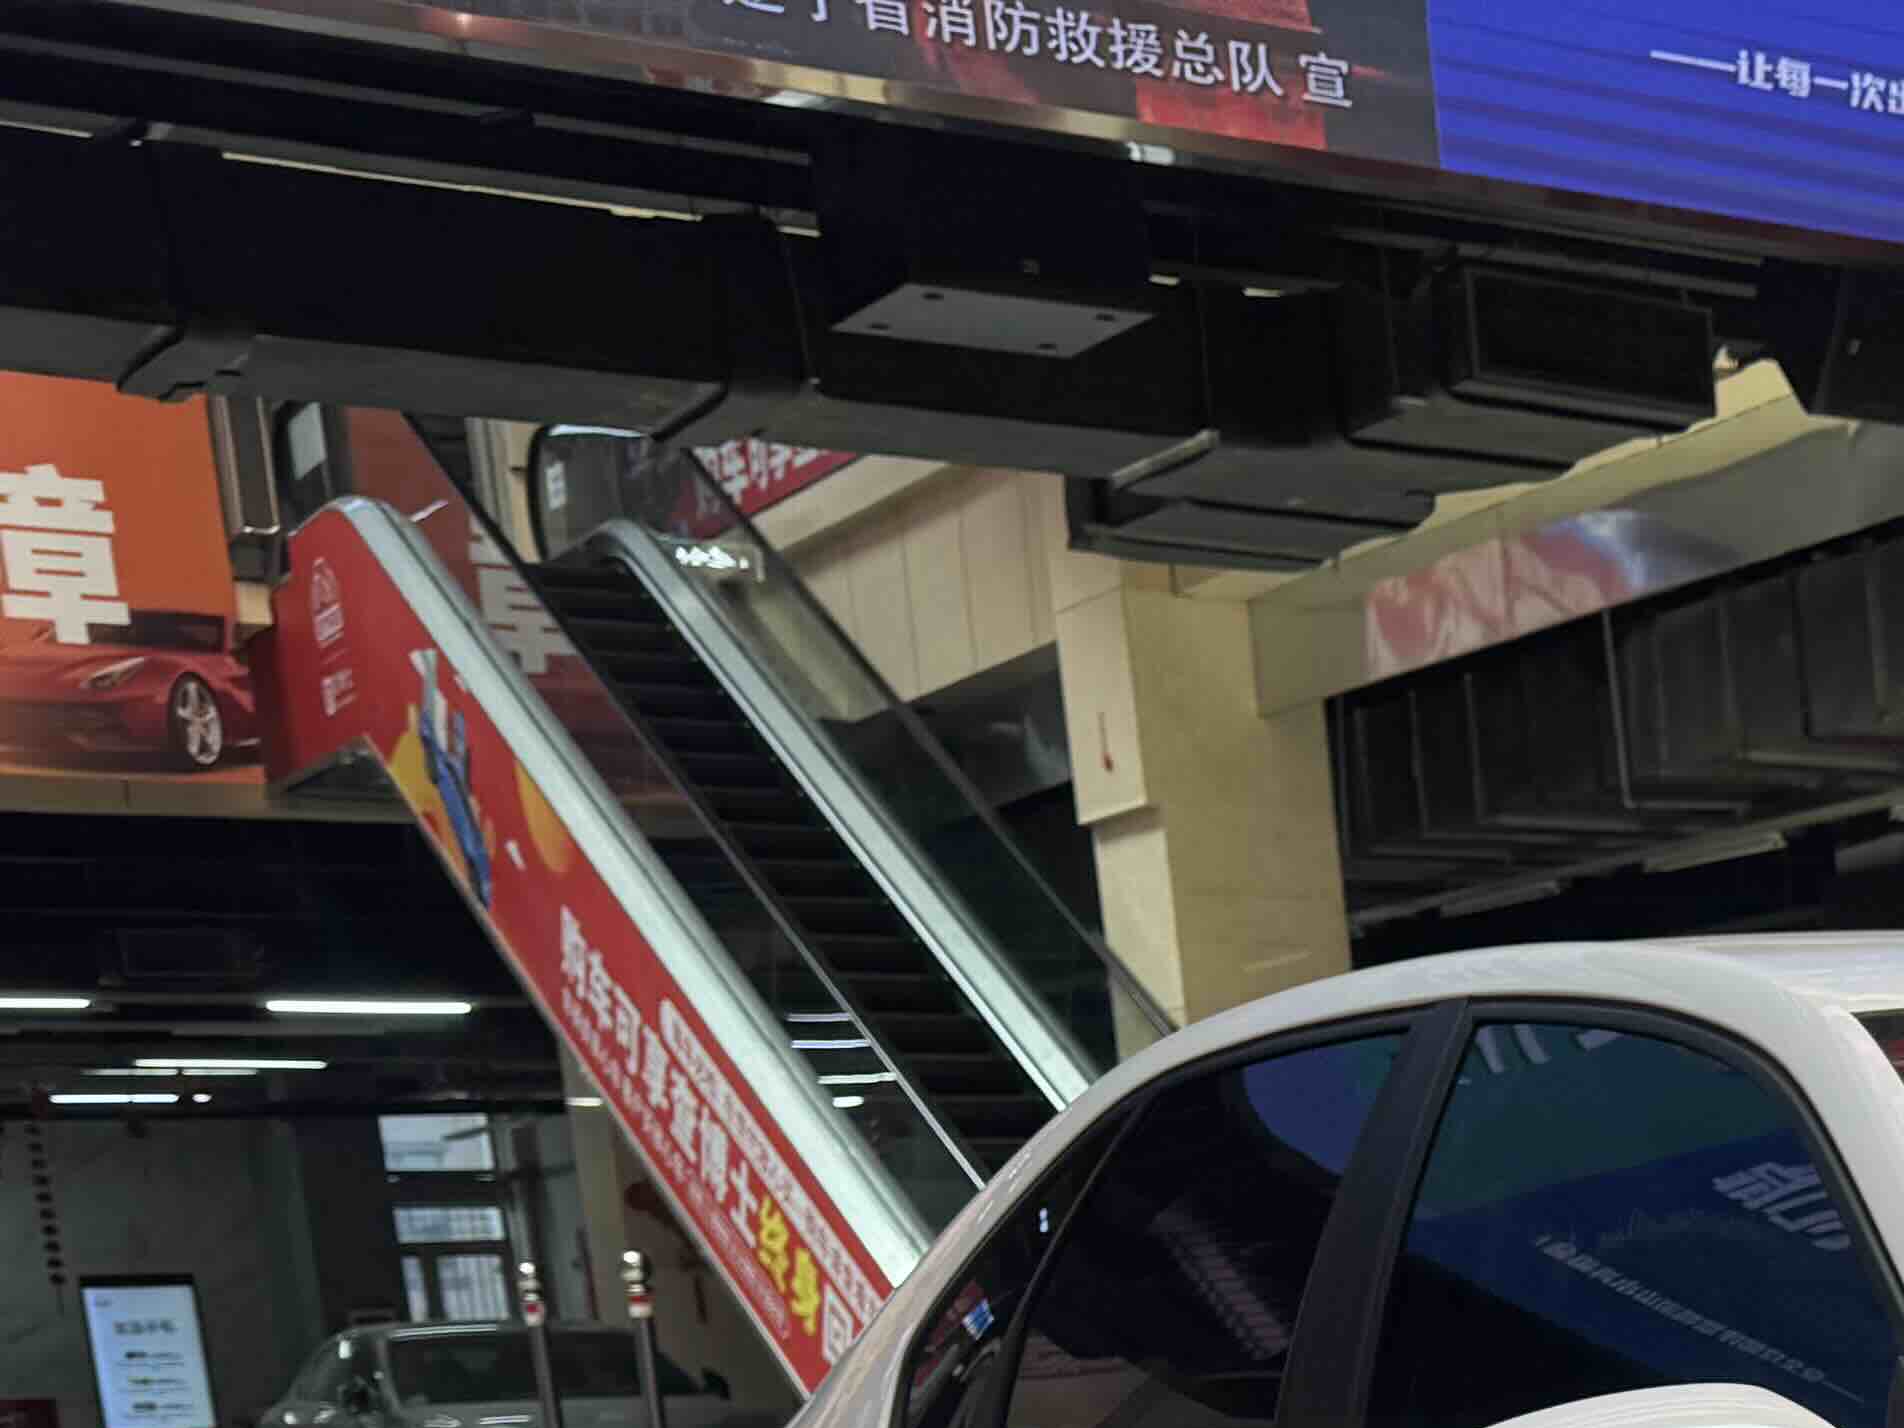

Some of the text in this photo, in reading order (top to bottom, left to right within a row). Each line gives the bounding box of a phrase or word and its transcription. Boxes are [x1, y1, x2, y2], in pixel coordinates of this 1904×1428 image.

[724, 0, 1354, 108] 省消防救援总队 宣
